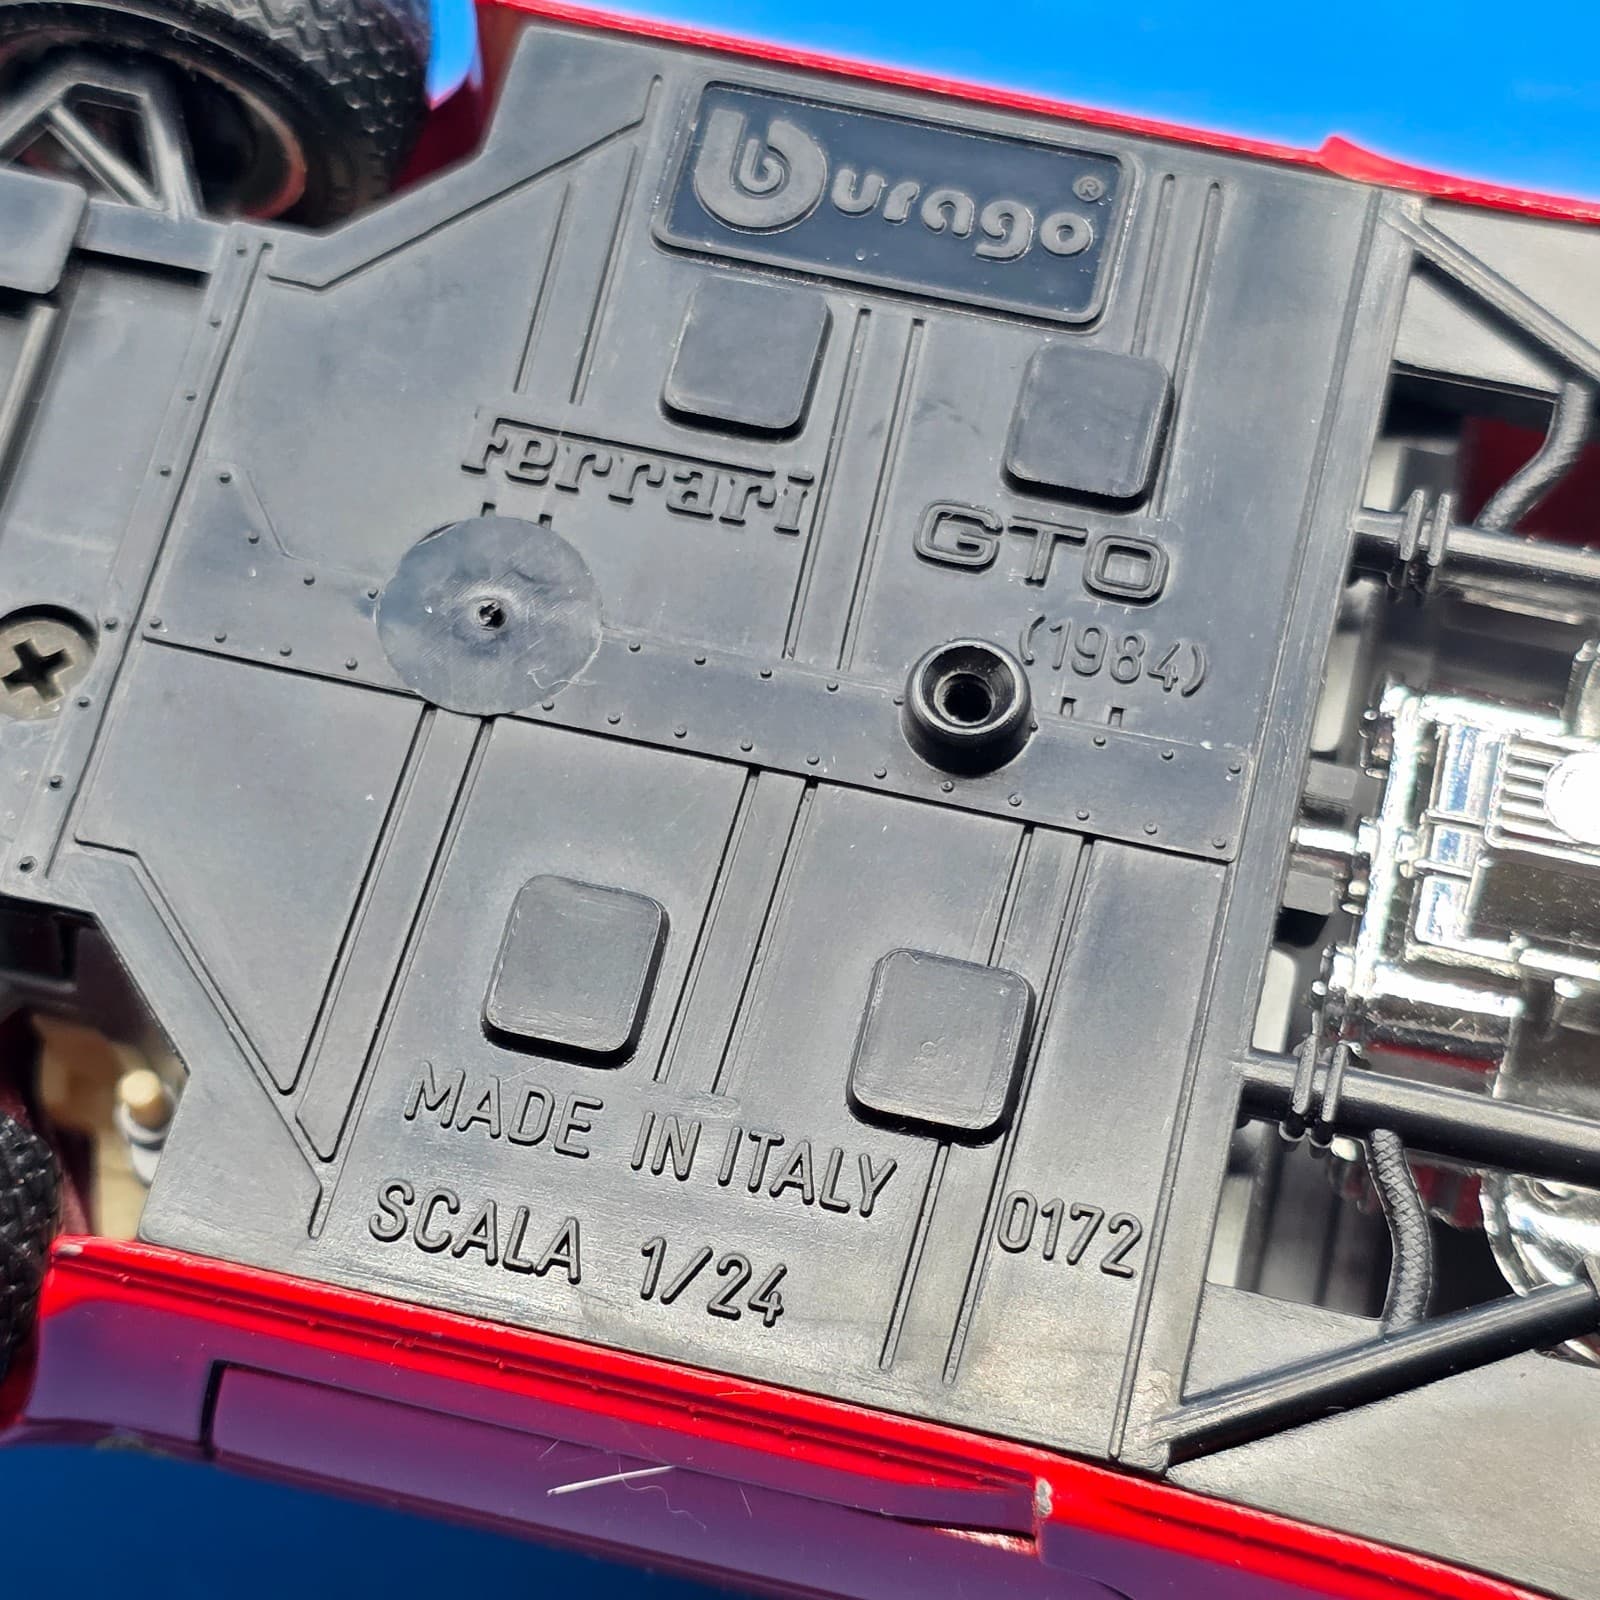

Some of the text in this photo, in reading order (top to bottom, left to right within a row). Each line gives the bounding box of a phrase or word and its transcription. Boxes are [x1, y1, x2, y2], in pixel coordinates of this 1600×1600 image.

[693, 108, 1095, 263] burago
[460, 406, 815, 537] Ferrari
[913, 500, 1170, 608] GTO
[1019, 614, 1207, 698] (1984)
[403, 1060, 898, 1218] MADE IN ITALY
[368, 1177, 788, 1329] SCALA 1/24
[998, 1189, 1144, 1279] 0172
